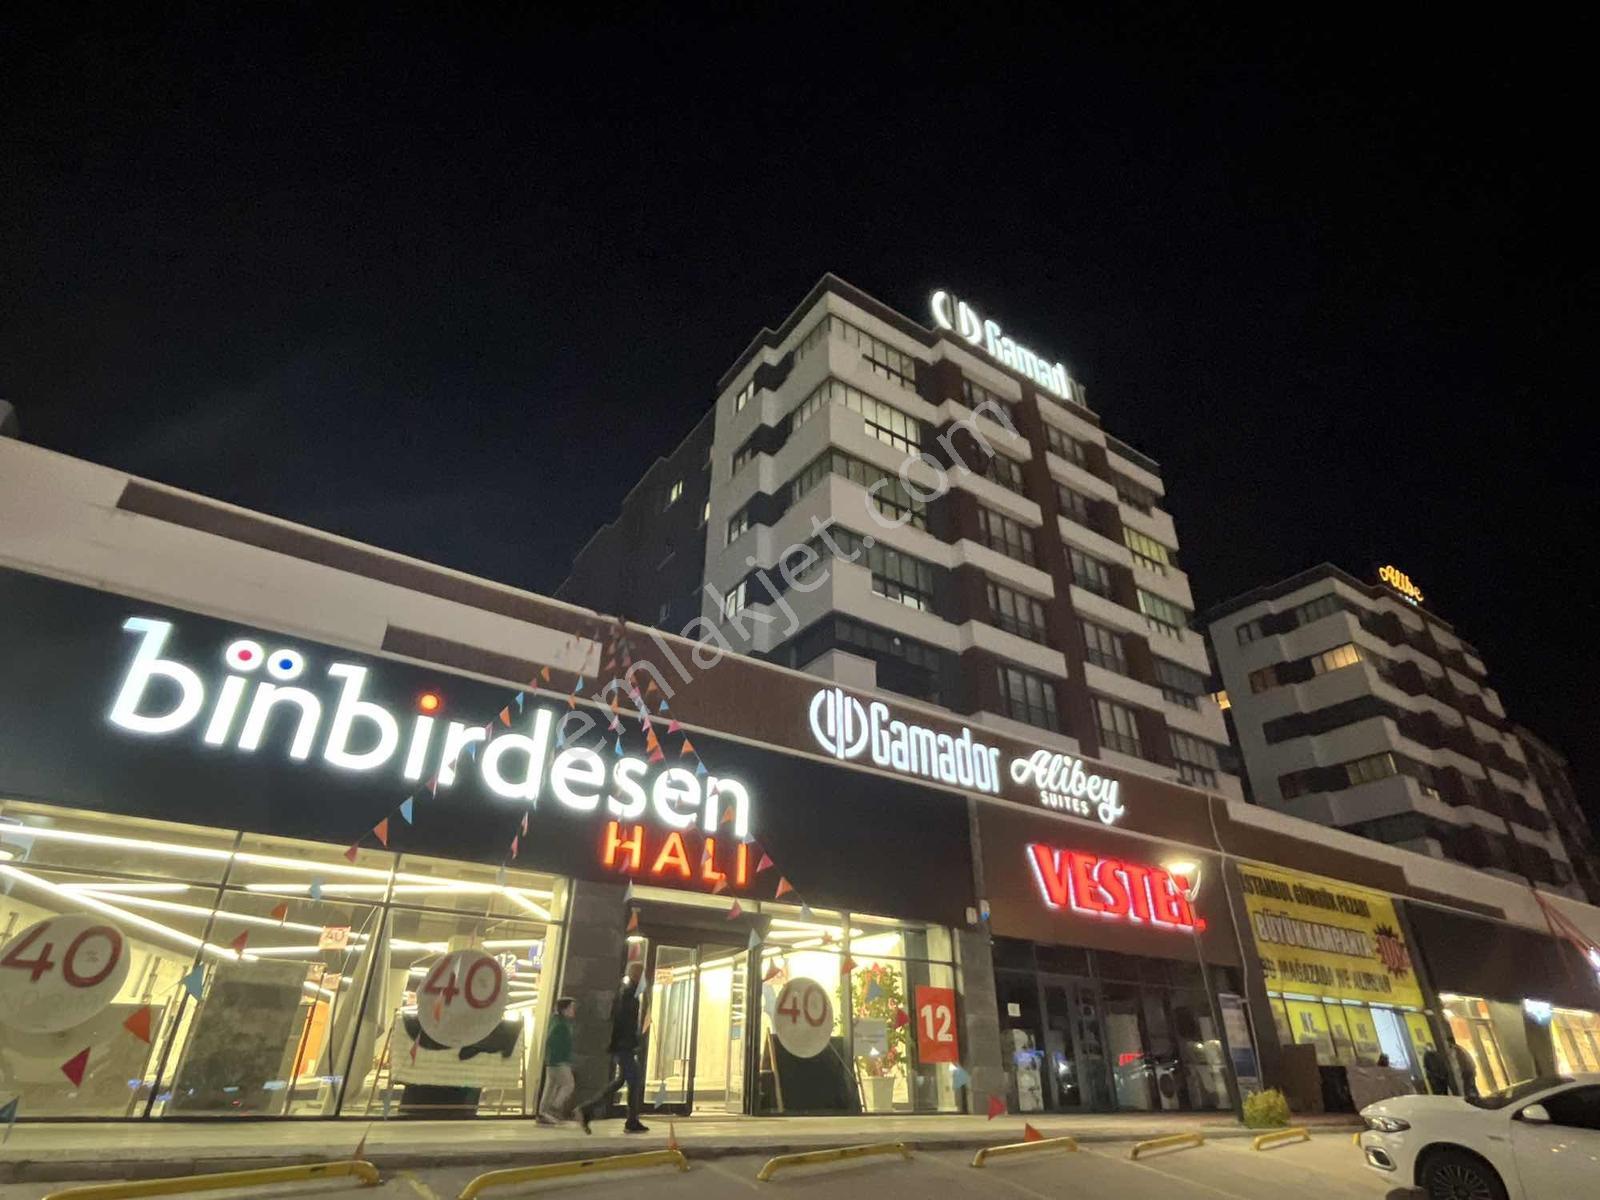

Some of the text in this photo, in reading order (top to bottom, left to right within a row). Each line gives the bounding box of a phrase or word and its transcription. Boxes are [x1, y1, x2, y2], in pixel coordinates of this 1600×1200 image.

[870, 702, 1000, 794] Gamador
[1010, 748, 1124, 825] Alibey
[1040, 790, 1090, 817] SUITES
[603, 820, 748, 886] HALI
[0, 920, 123, 988] 40
[422, 955, 503, 1010] 40
[777, 984, 828, 1028] 40
[920, 1003, 953, 1043] 12
